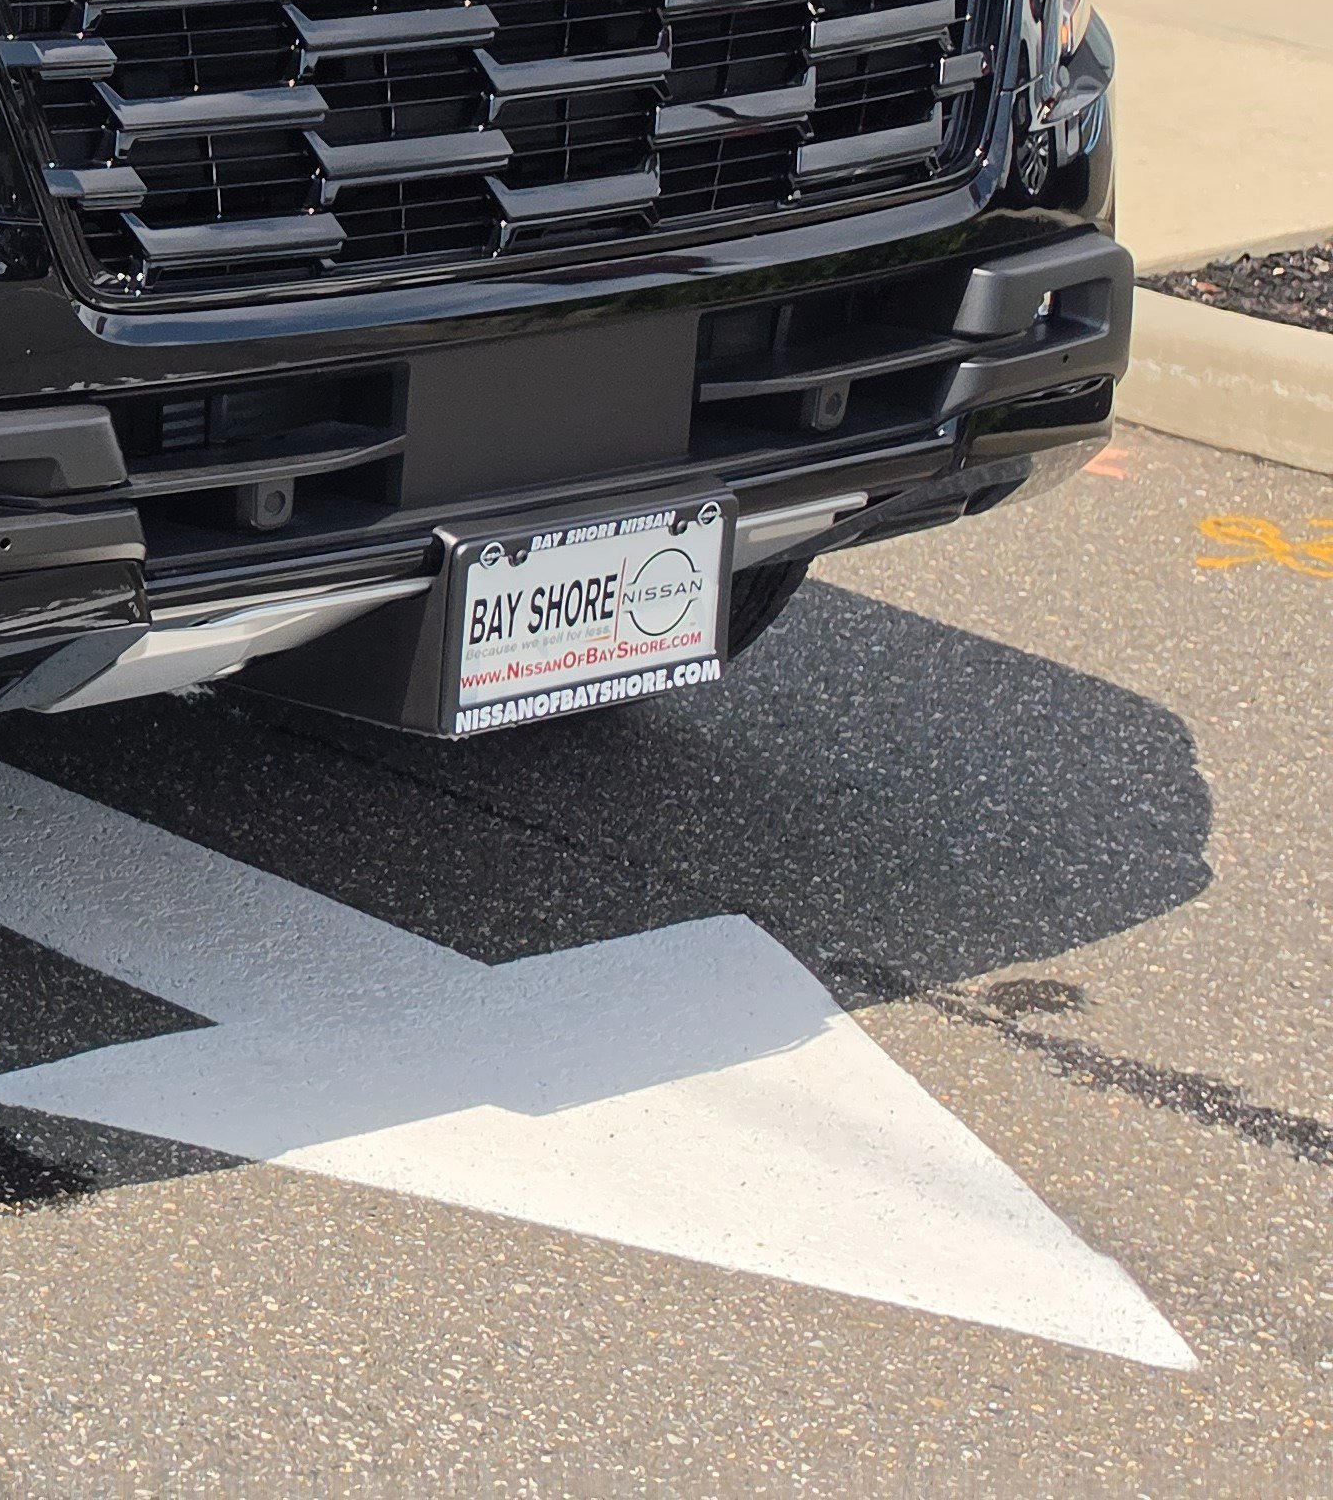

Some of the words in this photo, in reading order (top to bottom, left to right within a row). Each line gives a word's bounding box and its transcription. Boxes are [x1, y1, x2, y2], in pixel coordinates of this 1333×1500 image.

[531, 531, 563, 551] BAY
[566, 521, 617, 545] SHORE
[619, 510, 677, 535] NISSAN
[468, 590, 523, 645] BAY
[527, 573, 618, 634] SHORE
[622, 578, 703, 605] NISSAN
[465, 642, 517, 661] Because
[566, 629, 582, 642] for
[454, 658, 721, 734] NISSANOFBAYSHORE.COM
